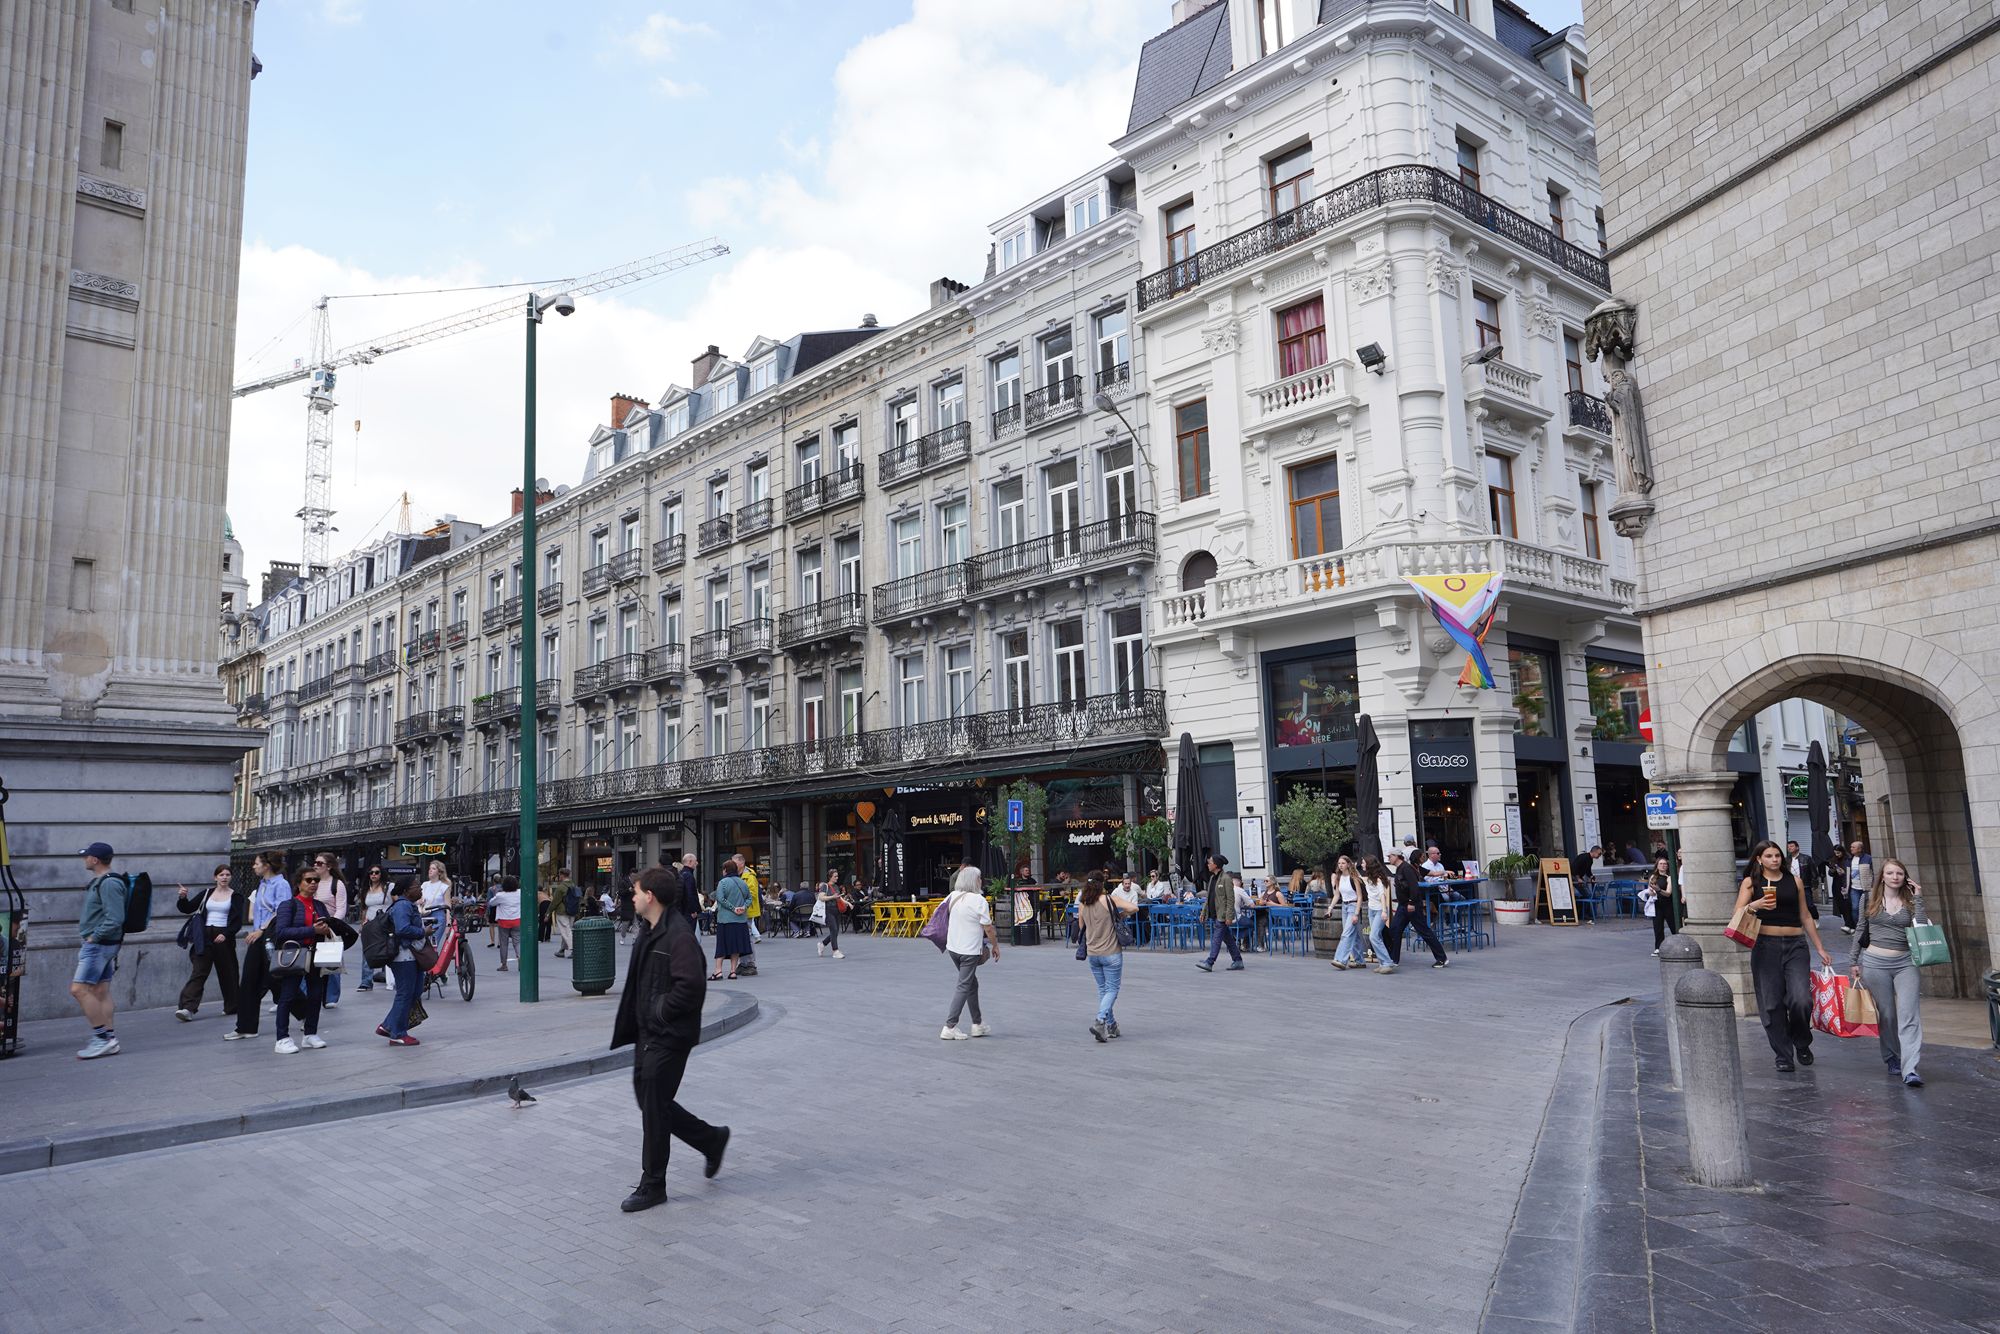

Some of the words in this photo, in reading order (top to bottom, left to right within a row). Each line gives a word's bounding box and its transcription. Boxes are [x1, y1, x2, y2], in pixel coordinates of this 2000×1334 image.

[1417, 752, 1469, 768] Casco
[911, 815, 932, 827] Brunch
[933, 814, 939, 825] &
[939, 812, 963, 826] Waffles
[1066, 819, 1087, 829] HAPPY
